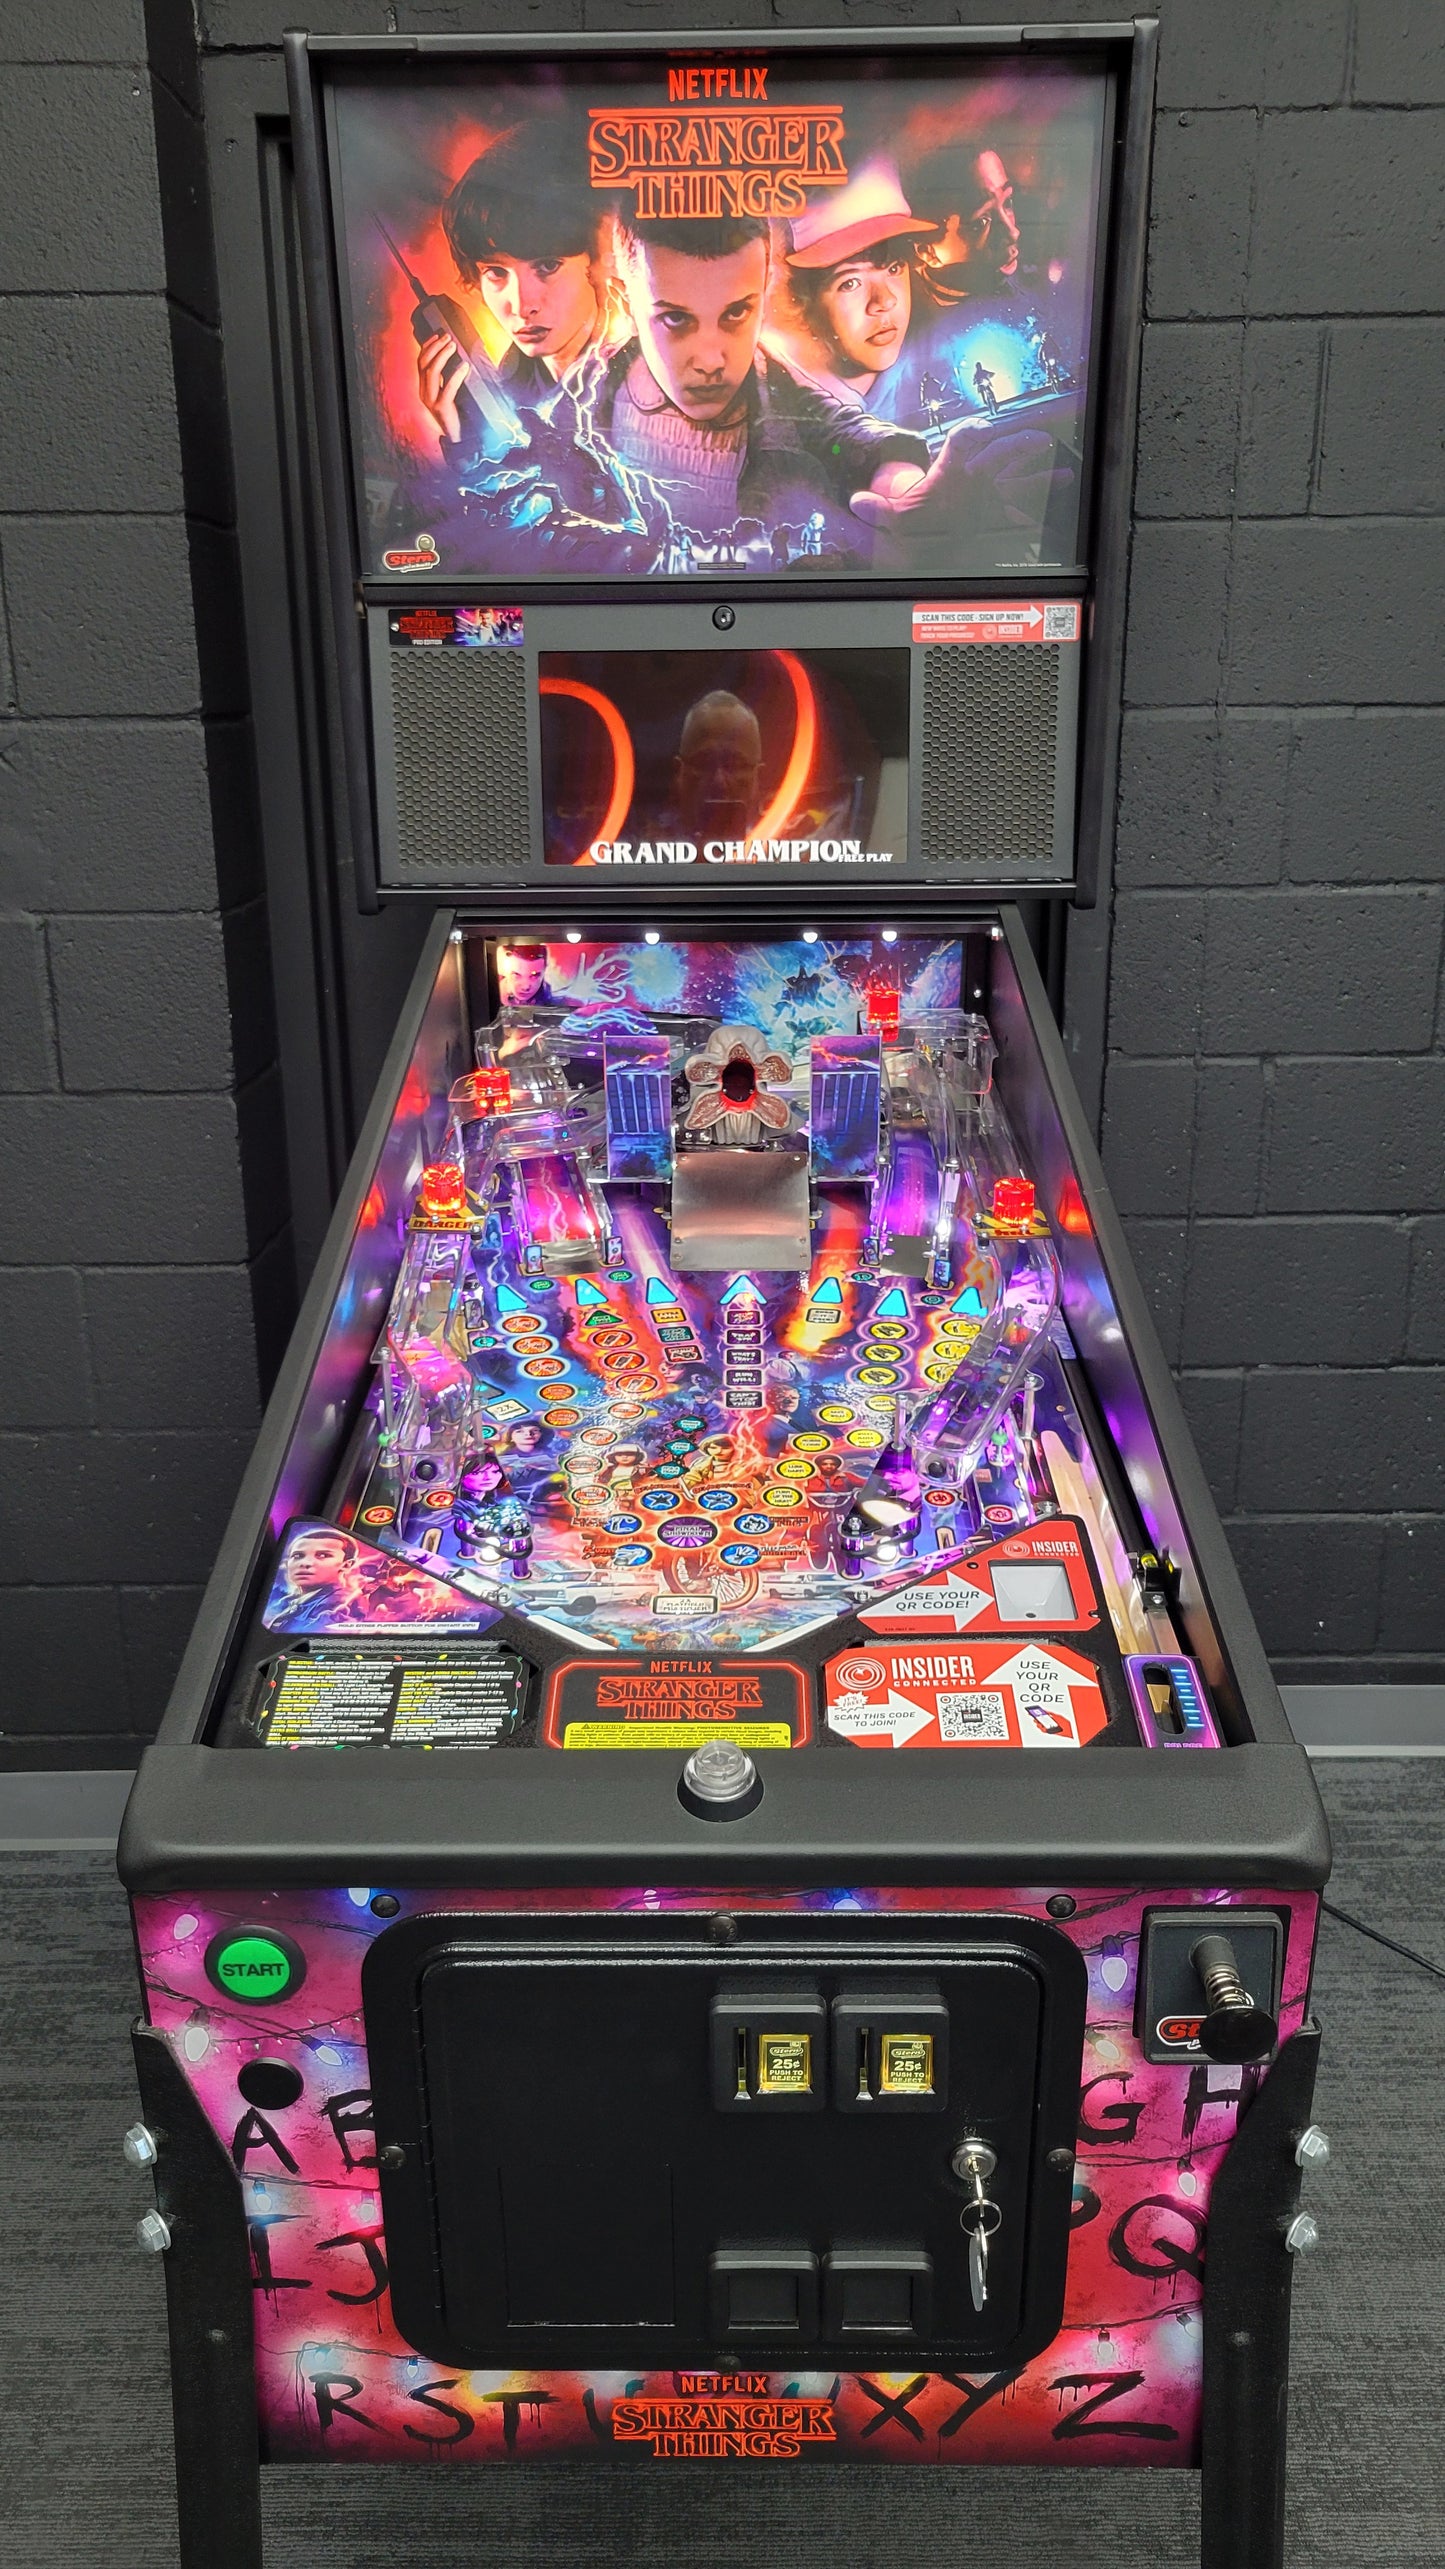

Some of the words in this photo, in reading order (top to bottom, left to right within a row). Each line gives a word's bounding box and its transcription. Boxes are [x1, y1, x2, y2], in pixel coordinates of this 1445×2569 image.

[668, 68, 768, 101] NETFLIX
[588, 116, 848, 179] STRANGER
[629, 169, 807, 218] THINGS
[921, 613, 939, 622] SCAN
[941, 613, 956, 621] THIS
[957, 613, 974, 621] CODE
[978, 613, 995, 621] SIGN
[996, 613, 1005, 621] UP
[589, 841, 697, 864] GRAND
[703, 839, 861, 864] CHAMPION
[838, 853, 865, 862] FREE
[866, 853, 892, 862] PLAY
[1032, 1541, 1078, 1553] INSIDER
[905, 1592, 934, 1600] USE
[939, 1591, 980, 1600] YOUR
[896, 1602, 916, 1610] QR
[922, 1601, 969, 1609] CODE!
[650, 1661, 712, 1673] NETFLIX
[891, 1656, 976, 1679] INSIDER
[1020, 1661, 1051, 1670] USE
[1016, 1671, 1059, 1681] YOUR
[893, 1679, 977, 1688] CONNECTED
[1028, 1683, 1051, 1692] QR
[597, 1678, 763, 1704] STRANGER
[1020, 1694, 1064, 1703] CODE
[624, 1700, 737, 1719] THINGS
[888, 1711, 916, 1719] CODE
[870, 1719, 896, 1727] JOIN!
[222, 1963, 284, 1977] START
[772, 2058, 800, 2070] 25¢
[894, 2060, 922, 2072] 25¢
[681, 2376, 767, 2393] NETFLIX
[611, 2403, 837, 2436] STRANGER
[650, 2431, 801, 2457] THINGS
